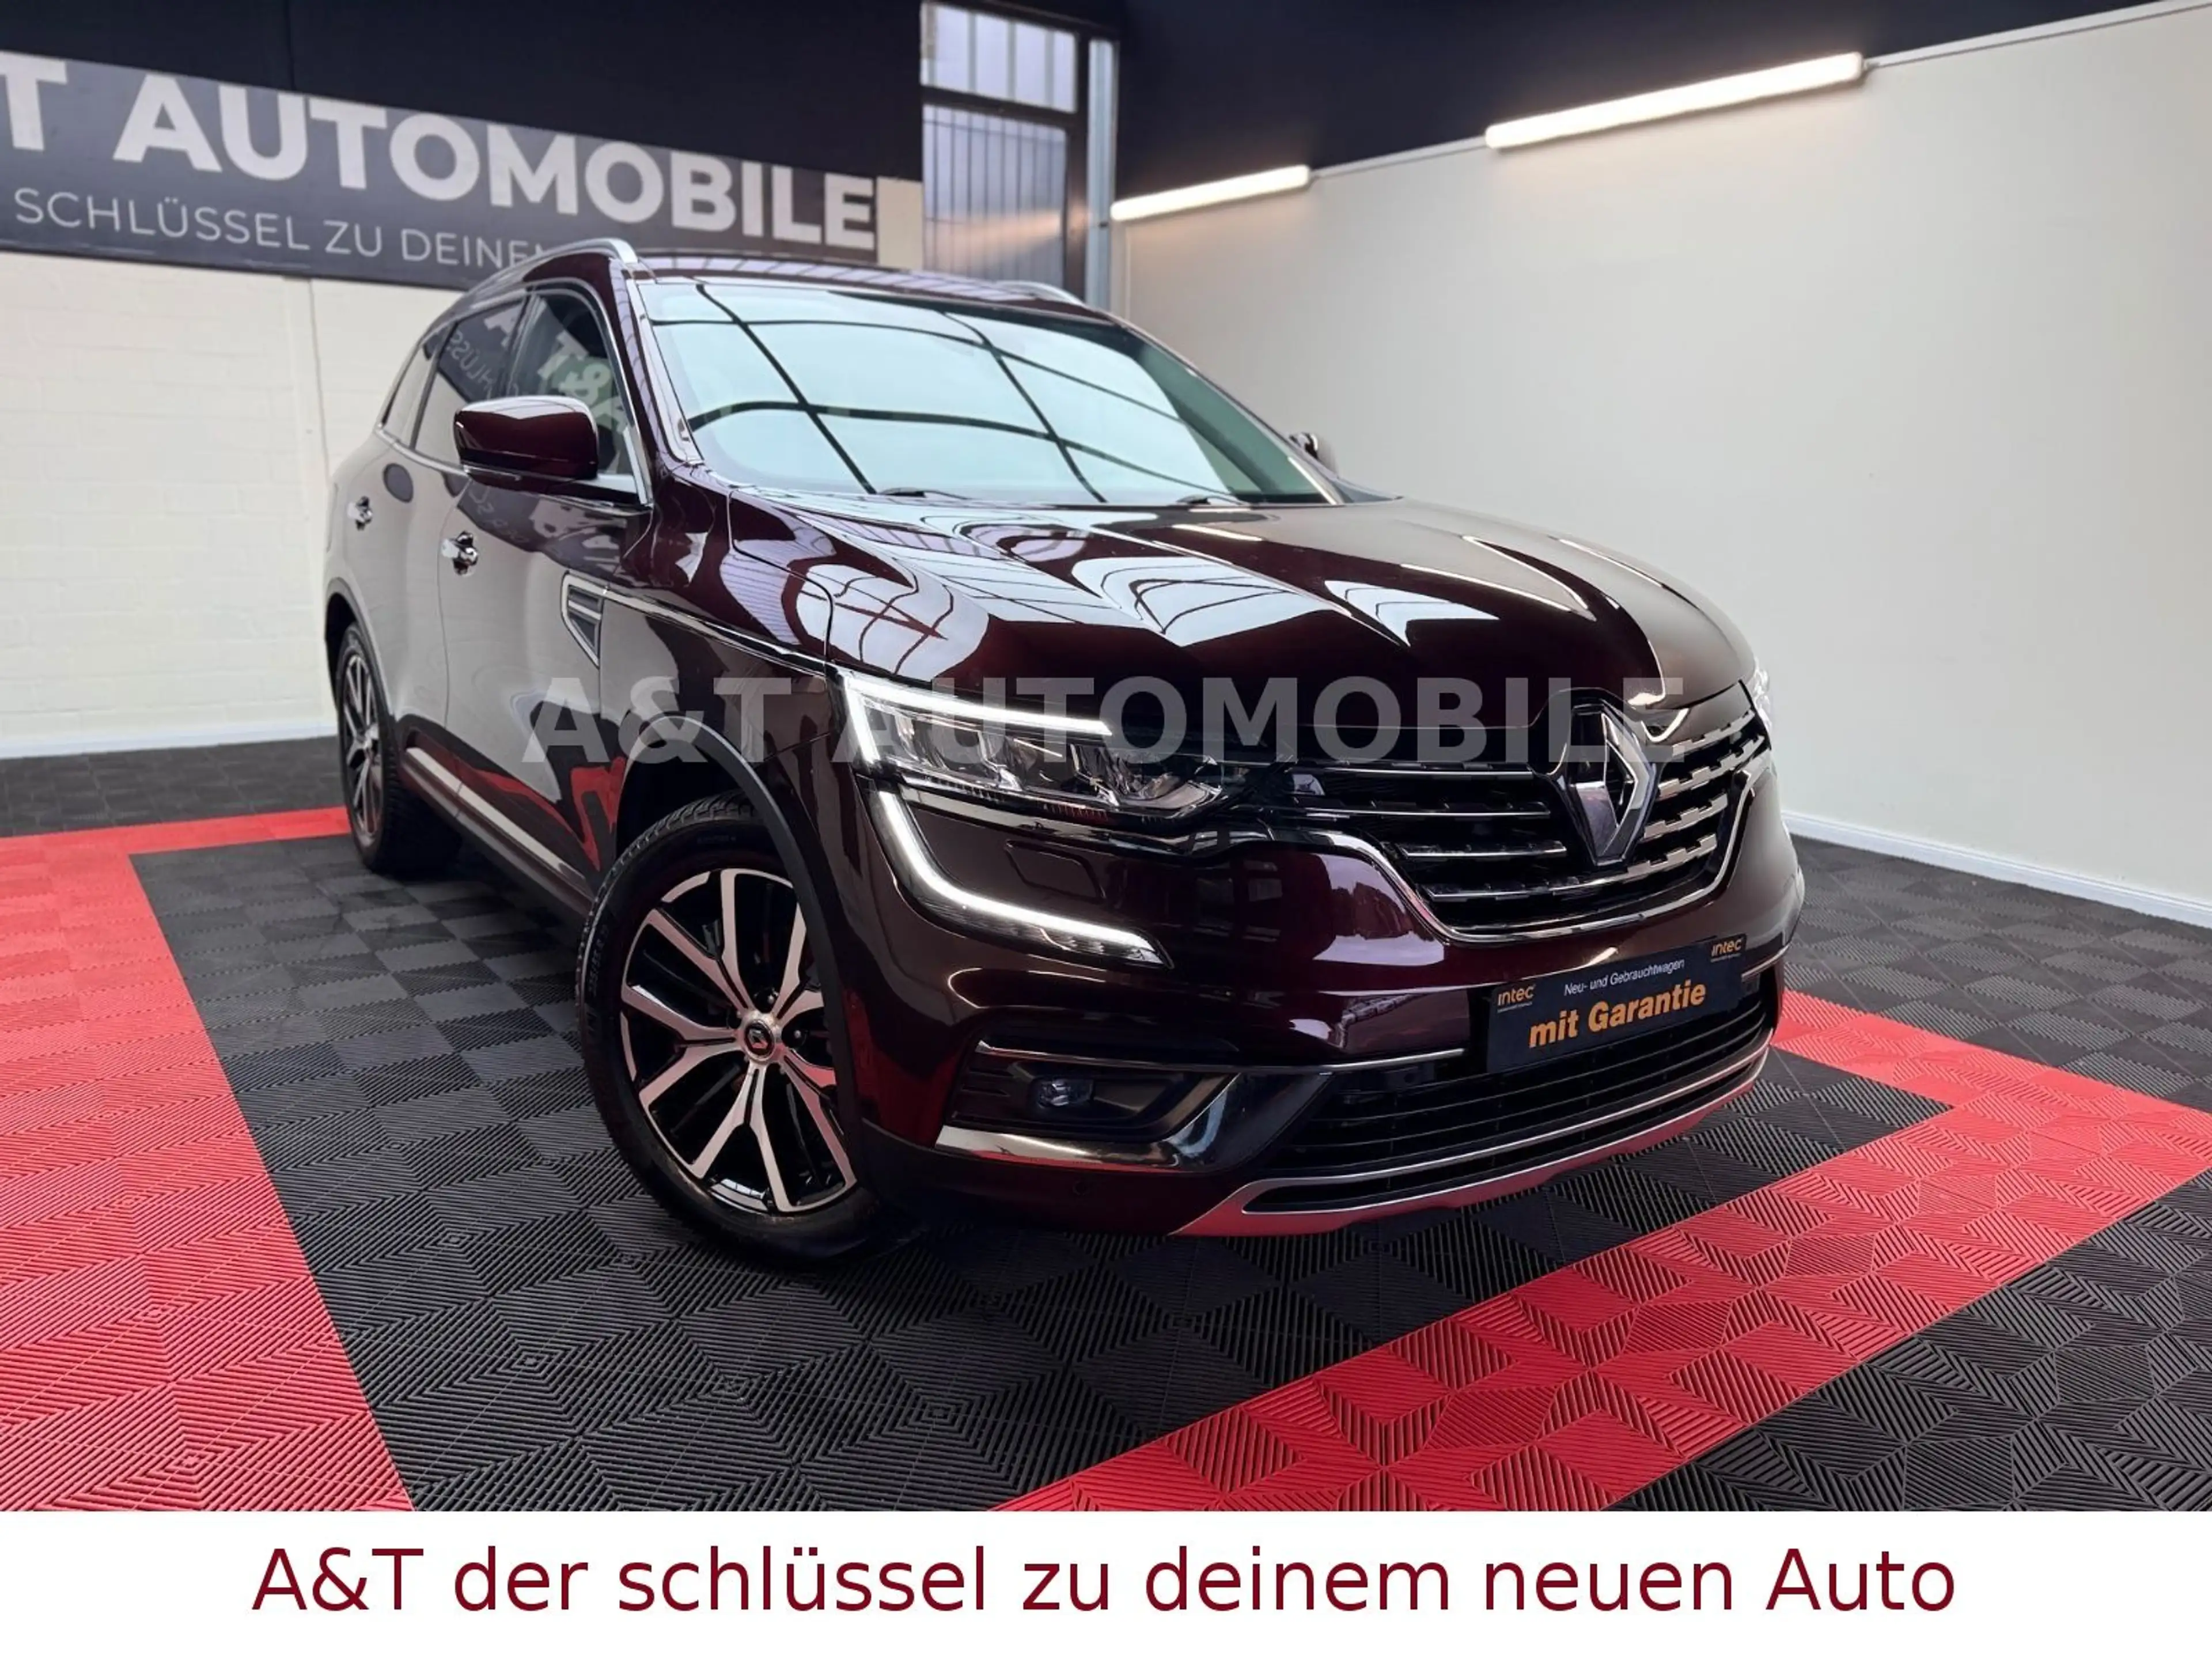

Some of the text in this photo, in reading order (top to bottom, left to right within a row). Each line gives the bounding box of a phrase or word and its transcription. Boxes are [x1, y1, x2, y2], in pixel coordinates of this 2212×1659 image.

[113, 73, 875, 250] AUTOMOBILE
[14, 187, 543, 268] SCHLÜSSEL ZU DEINE
[1710, 938, 1744, 957] intec
[1498, 986, 1534, 1006] intec
[1563, 959, 1685, 996] Neu- und Gebrauchtwagen
[1529, 979, 1706, 1048] mit Garantie
